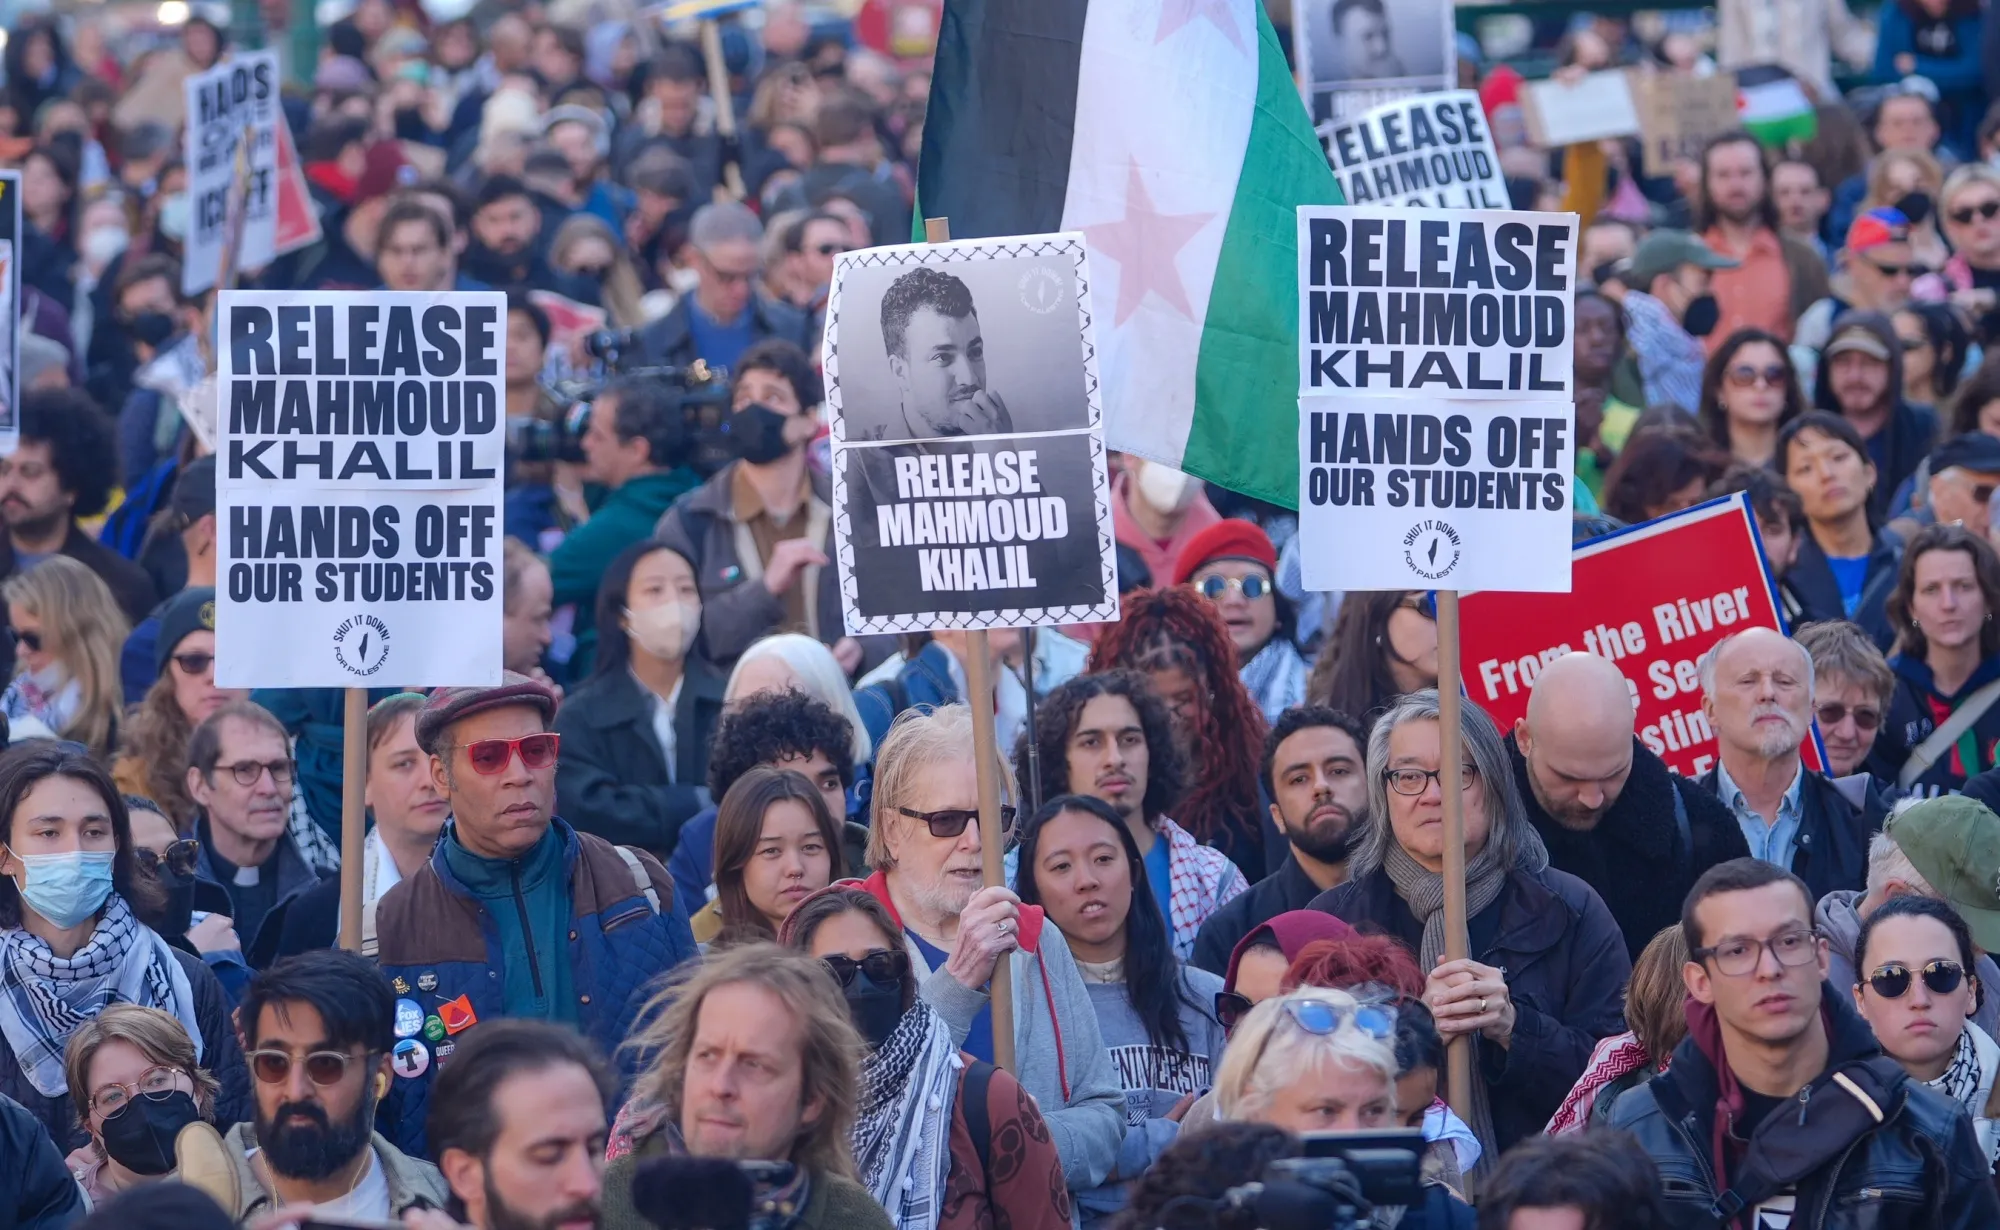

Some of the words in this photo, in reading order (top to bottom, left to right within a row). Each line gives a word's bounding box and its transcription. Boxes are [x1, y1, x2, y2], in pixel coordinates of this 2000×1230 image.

[1336, 150, 1492, 206] AHMOUD
[1310, 217, 1569, 291] RELEASE
[231, 305, 497, 377] RELEASE
[1310, 291, 1565, 348] MAHMOUD
[1310, 349, 1564, 391] KHALIL
[229, 380, 496, 436] MAHMOUD
[229, 440, 496, 481] KHALIL
[1310, 412, 1471, 467] HANDS
[1488, 416, 1566, 468] OFF
[894, 450, 1041, 498] RELEASE
[1309, 467, 1374, 506] OUR
[1387, 471, 1564, 511] STUDENTS
[230, 505, 400, 559] HANDS
[415, 505, 494, 558] OFF
[876, 496, 1069, 547] MAHMOUD
[1403, 523, 1423, 547] SHUT
[1424, 519, 1433, 531] IT
[1435, 520, 1461, 547] DOWN!
[229, 563, 302, 602] OUR
[316, 562, 493, 602] STUDENTS
[918, 545, 1038, 592] KHALIL
[1404, 550, 1417, 572] FOR
[1416, 549, 1461, 580] PALESTINE
[333, 618, 353, 643] SHUT
[354, 614, 363, 626] IT
[365, 614, 391, 641] DOWN!
[1584, 621, 1647, 662] the
[1652, 585, 1750, 645] River
[334, 646, 348, 669] FOR
[347, 644, 390, 677] PALESTINE
[1648, 652, 1708, 700] Se
[1110, 1045, 1212, 1094] NIVERSIT
[1127, 1094, 1152, 1105] OLA
